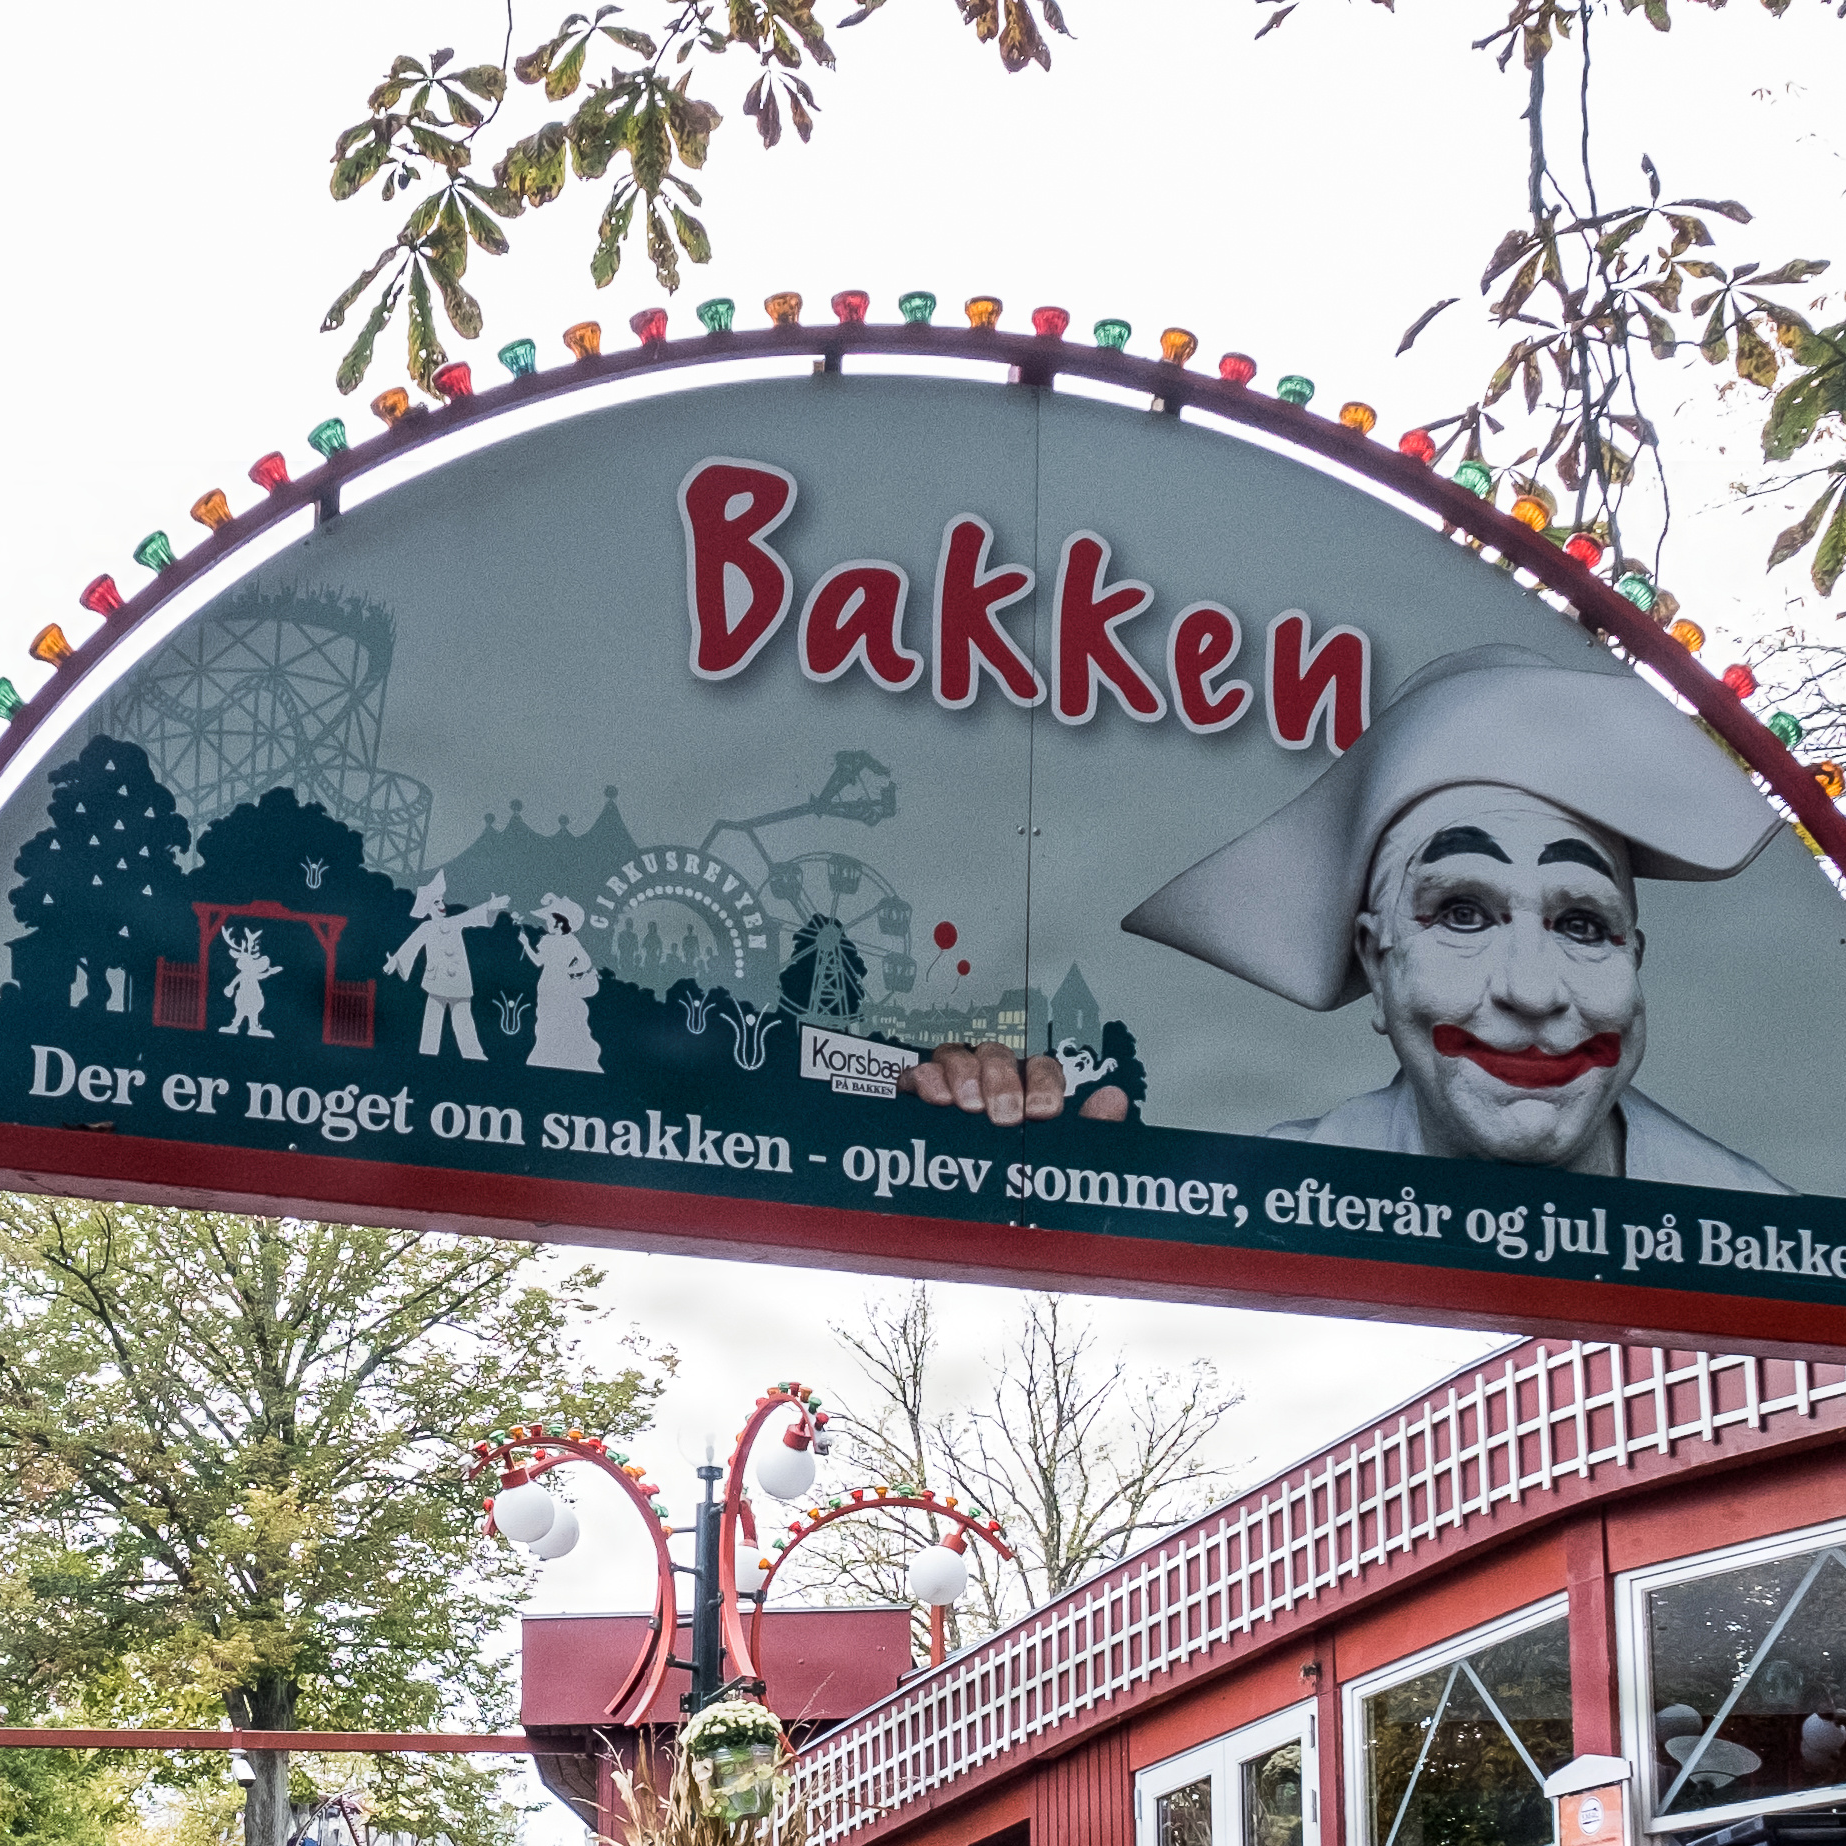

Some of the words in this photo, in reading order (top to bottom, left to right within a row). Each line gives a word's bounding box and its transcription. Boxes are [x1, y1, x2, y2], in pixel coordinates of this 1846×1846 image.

[678, 457, 1371, 758] Bakken
[590, 851, 767, 949] CIRKUSREVYEN
[29, 1044, 144, 1106] Der
[162, 1076, 229, 1116] er
[247, 1080, 413, 1142] noget
[431, 1101, 526, 1144] om
[542, 1110, 793, 1174] snakken
[842, 1139, 991, 1198] oplev
[1007, 1162, 1249, 1229] sommer,
[1264, 1177, 1452, 1240] efterår
[1465, 1209, 1529, 1260] og
[1536, 1201, 1610, 1263] jul
[1623, 1213, 1684, 1273] på
[852, 1081, 894, 1095] BAKKEN
